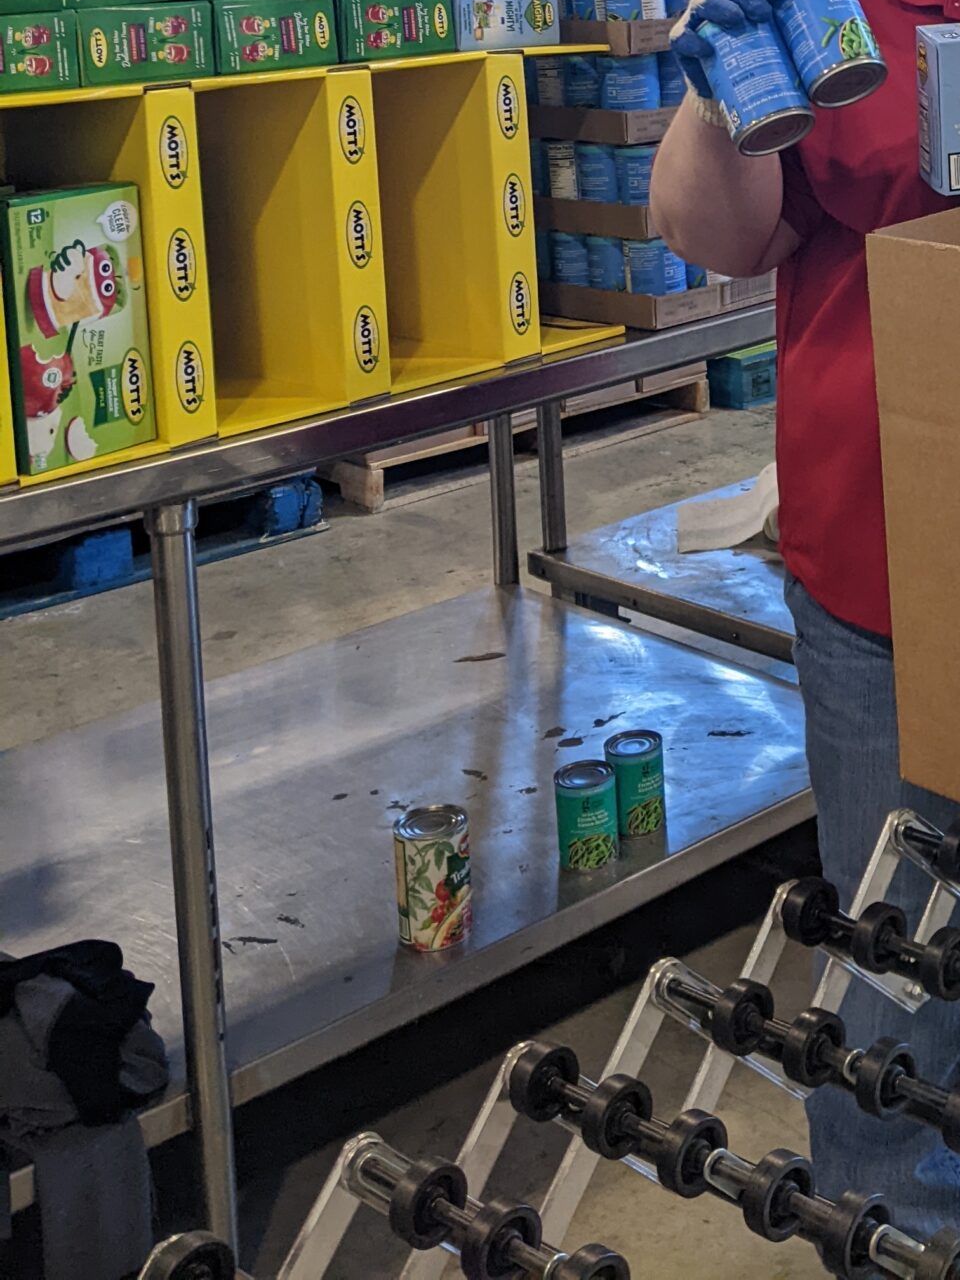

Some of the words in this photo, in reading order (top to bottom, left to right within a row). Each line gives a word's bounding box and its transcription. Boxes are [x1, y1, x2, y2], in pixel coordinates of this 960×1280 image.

[318, 16, 326, 46] MOTT'S
[437, 6, 445, 36] MOTT'S
[94, 32, 104, 64] MOTT'S
[345, 104, 359, 157] MOTT'S
[502, 83, 514, 132] MOTT'S
[167, 124, 182, 182] MOTT'S
[30, 210, 42, 224] 12
[112, 208, 125, 234] CLEAR
[509, 182, 520, 230] MOTT'S
[353, 208, 366, 262] MOTT'S
[175, 236, 190, 294] MOTT'S
[515, 280, 526, 328] MOTT'S
[361, 314, 374, 366] MOTT'S
[128, 358, 142, 416] MOTT'S
[183, 350, 198, 406] MOTT'S
